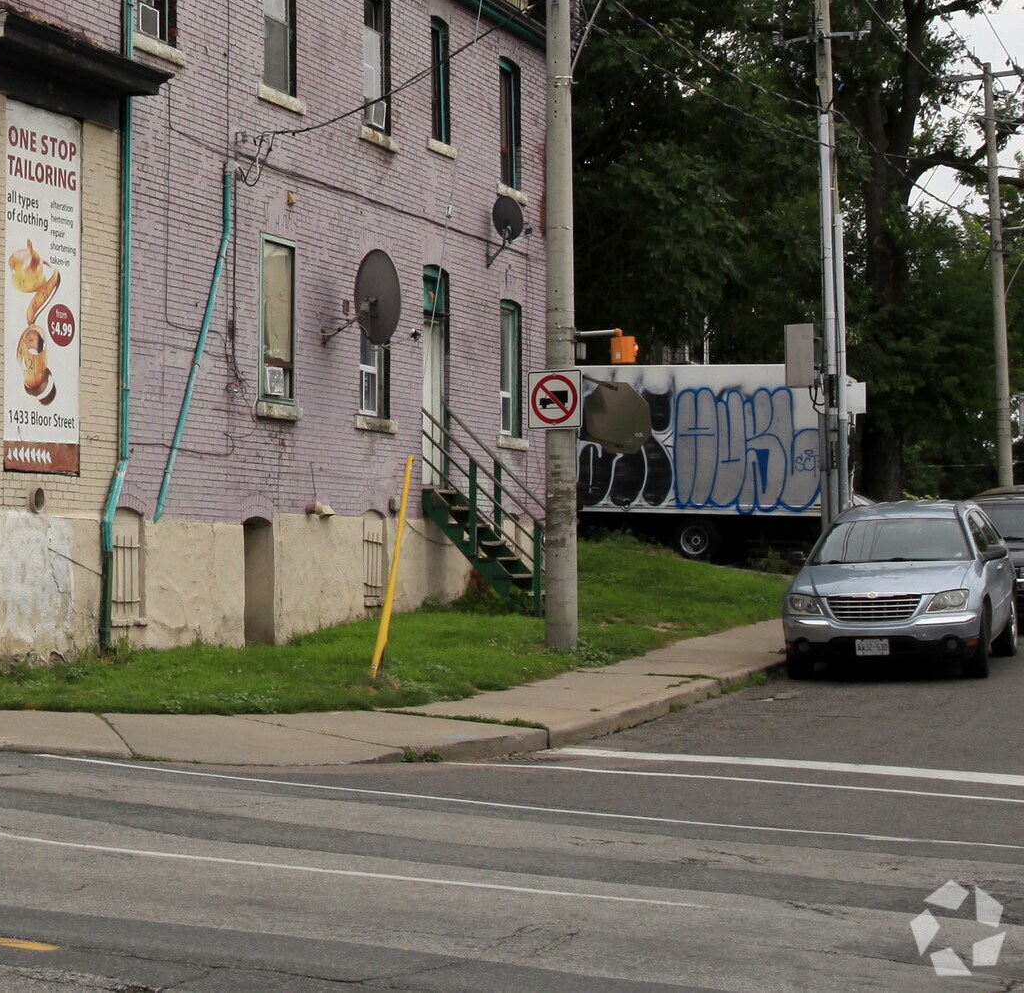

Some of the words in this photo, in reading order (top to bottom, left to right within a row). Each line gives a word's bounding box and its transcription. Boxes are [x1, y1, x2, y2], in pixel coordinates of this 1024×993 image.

[8, 125, 37, 153] ONE
[41, 134, 77, 162] STOP
[7, 154, 77, 192] TAILORING
[7, 190, 17, 204] all
[18, 193, 40, 210] types
[7, 208, 16, 221] of
[17, 209, 49, 232] clothing
[50, 214, 74, 228] hemming
[50, 228, 65, 239] repair
[50, 241, 77, 256] shortening
[55, 309, 68, 319] from
[50, 321, 73, 338] $4.99
[8, 409, 29, 425] 1433
[31, 412, 52, 427] Bloor
[53, 413, 75, 429] Street
